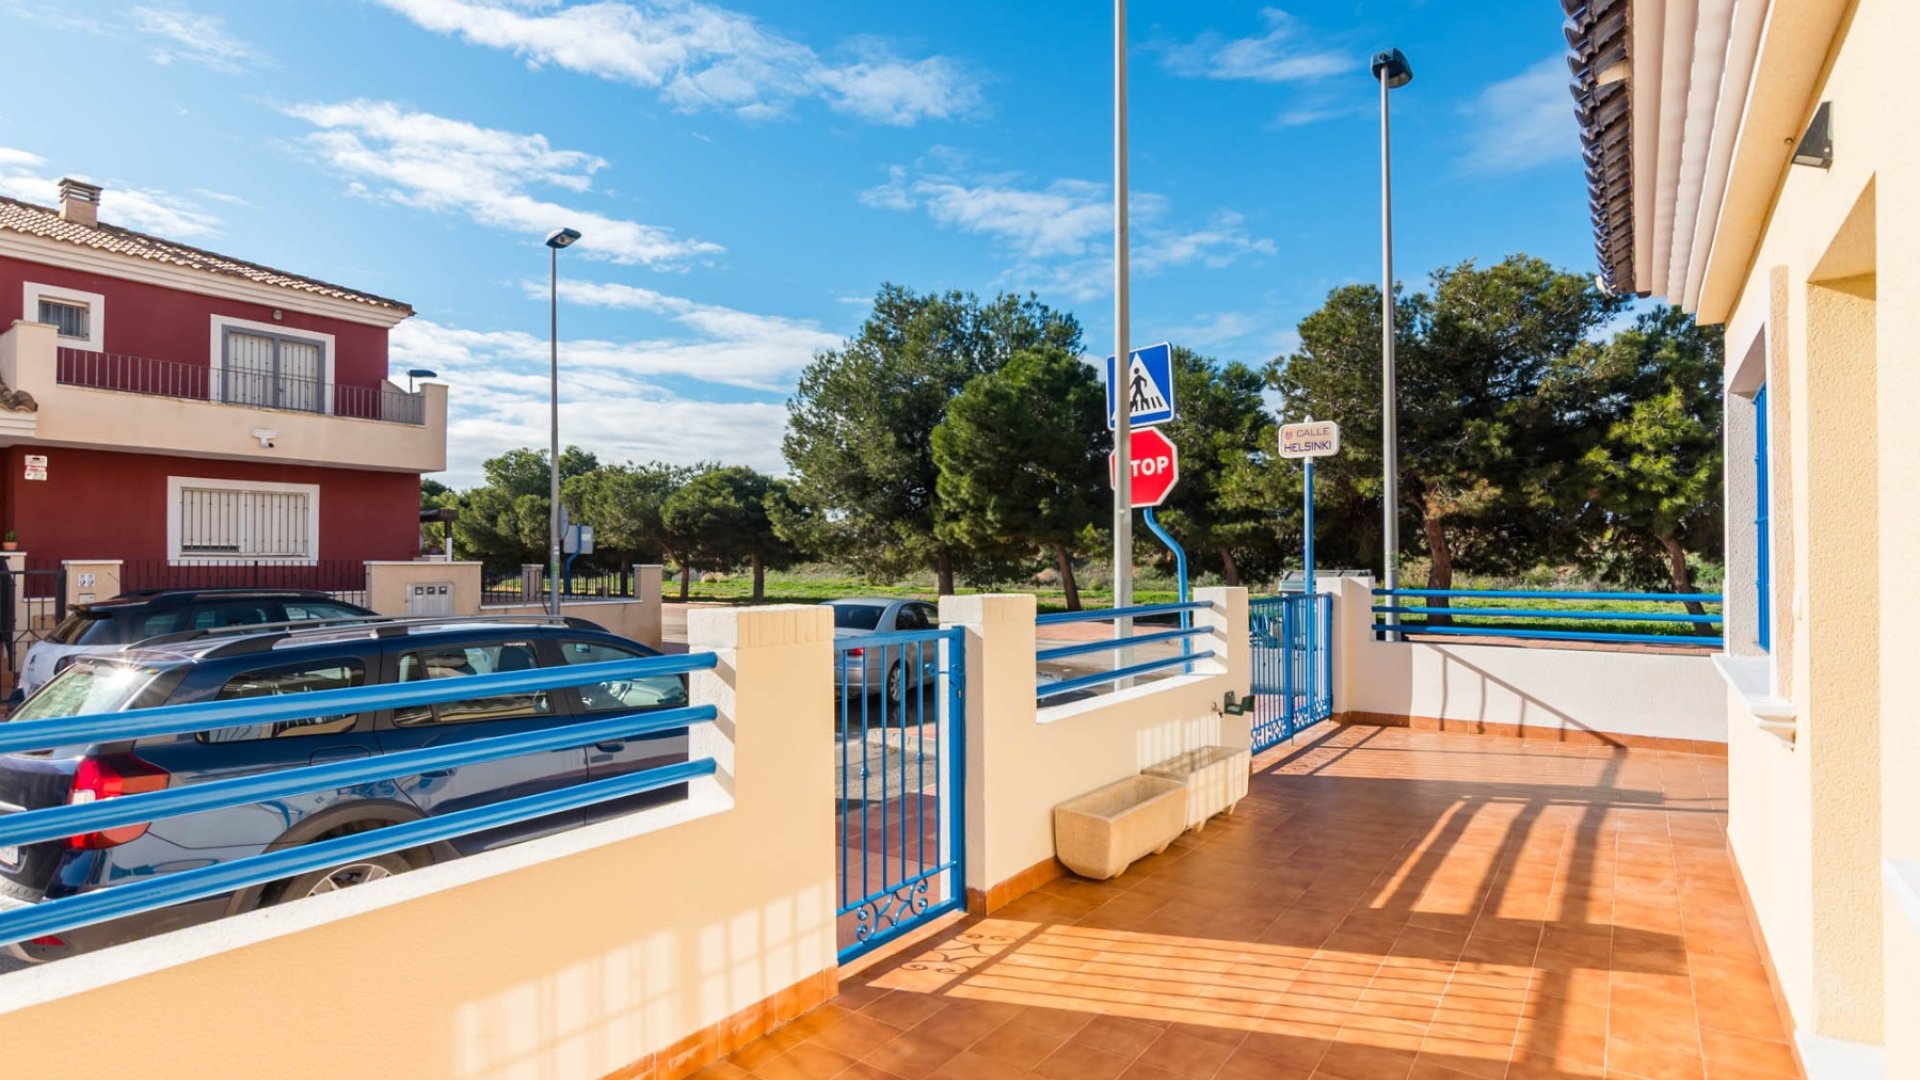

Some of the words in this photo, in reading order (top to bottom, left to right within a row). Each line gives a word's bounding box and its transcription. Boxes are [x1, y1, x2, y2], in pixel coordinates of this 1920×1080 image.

[1296, 427, 1330, 437] CALLE
[1284, 440, 1331, 452] HELSINKI
[1130, 456, 1169, 477] TOP
